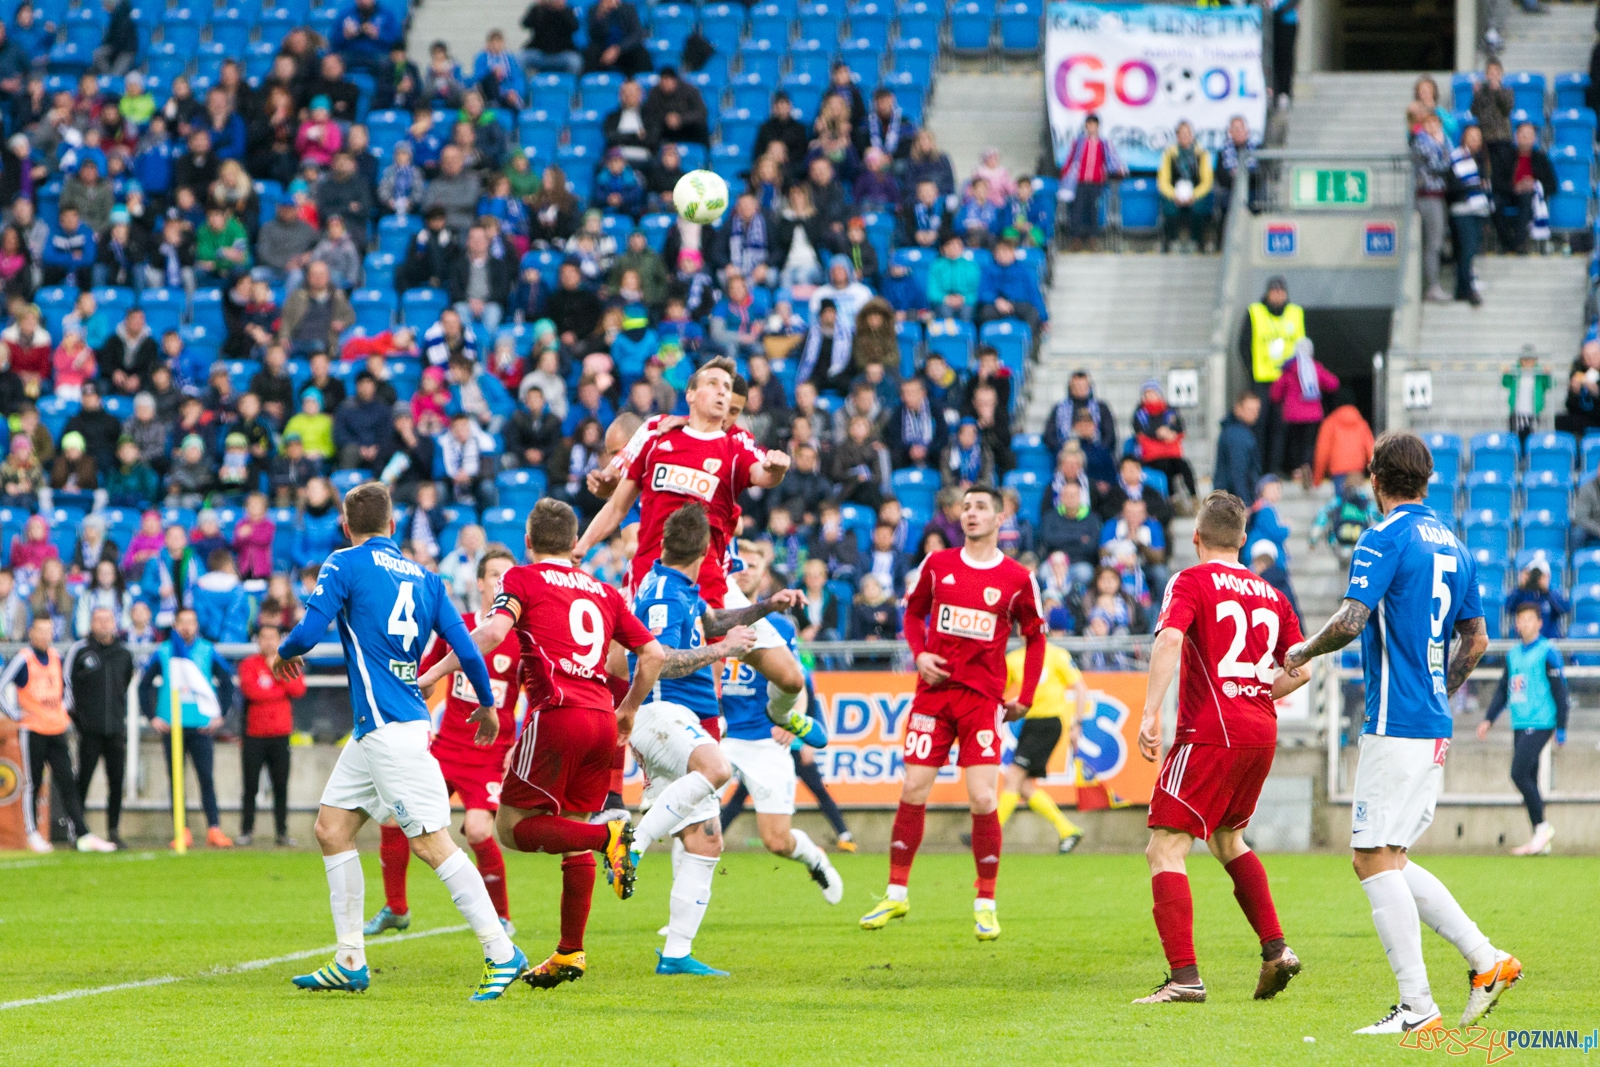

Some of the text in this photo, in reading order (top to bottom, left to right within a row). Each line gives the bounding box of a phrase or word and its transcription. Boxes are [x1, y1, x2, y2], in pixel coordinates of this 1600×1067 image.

[654, 466, 710, 494] etoto
[1211, 573, 1279, 602] MOKWA
[1430, 553, 1457, 637] 5
[388, 581, 419, 652] 4
[569, 598, 605, 669] 9
[941, 606, 991, 632] etoto
[1216, 600, 1280, 685] 22
[904, 731, 932, 760] 90
